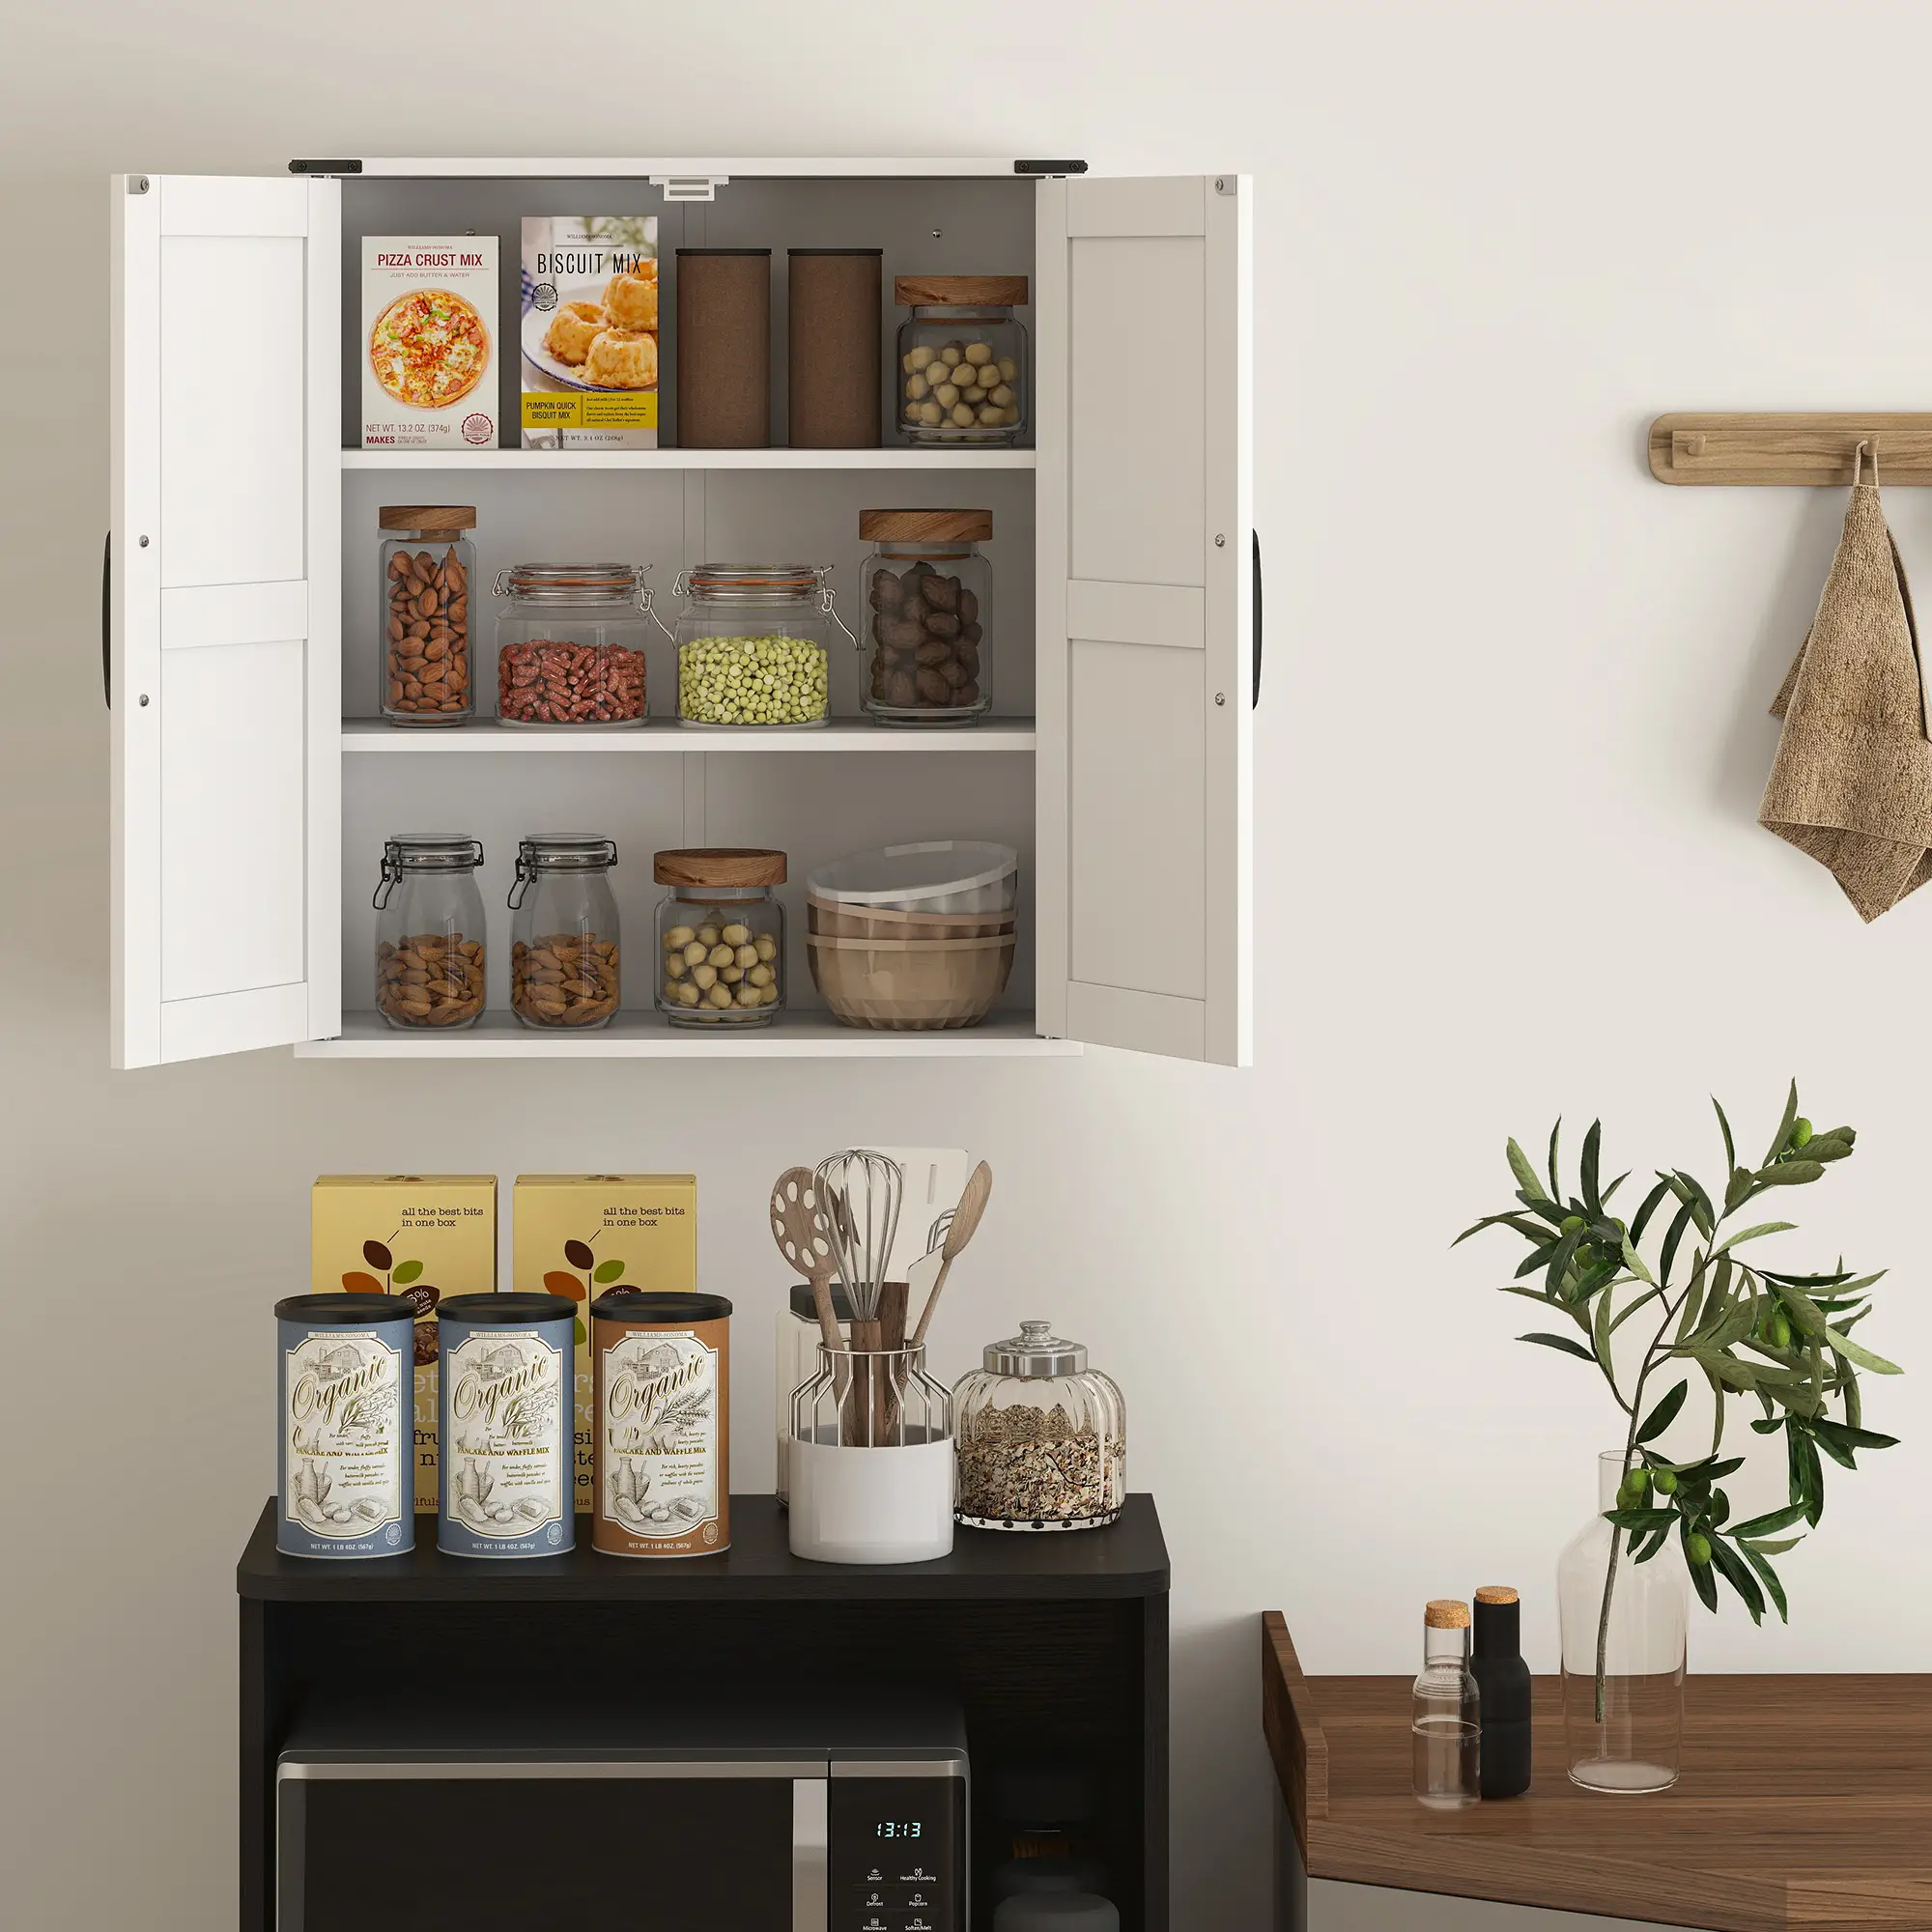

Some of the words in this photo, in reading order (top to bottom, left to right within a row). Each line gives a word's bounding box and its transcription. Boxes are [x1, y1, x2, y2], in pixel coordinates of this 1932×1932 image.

[378, 254, 412, 267] PIZZA
[415, 254, 456, 267] CRUST
[460, 254, 483, 267] MIX
[537, 253, 604, 274] BISCUIT
[612, 253, 641, 274] MIX
[366, 424, 380, 433] NET
[382, 424, 395, 433] WT.
[398, 424, 413, 433] 13.2
[428, 424, 451, 434] (374g)
[293, 1355, 386, 1426] Organic
[454, 1354, 549, 1425] Organic
[609, 1353, 705, 1425] Organic
[457, 1447, 487, 1456] PANCAKE
[877, 1822, 922, 1837] 13:13
